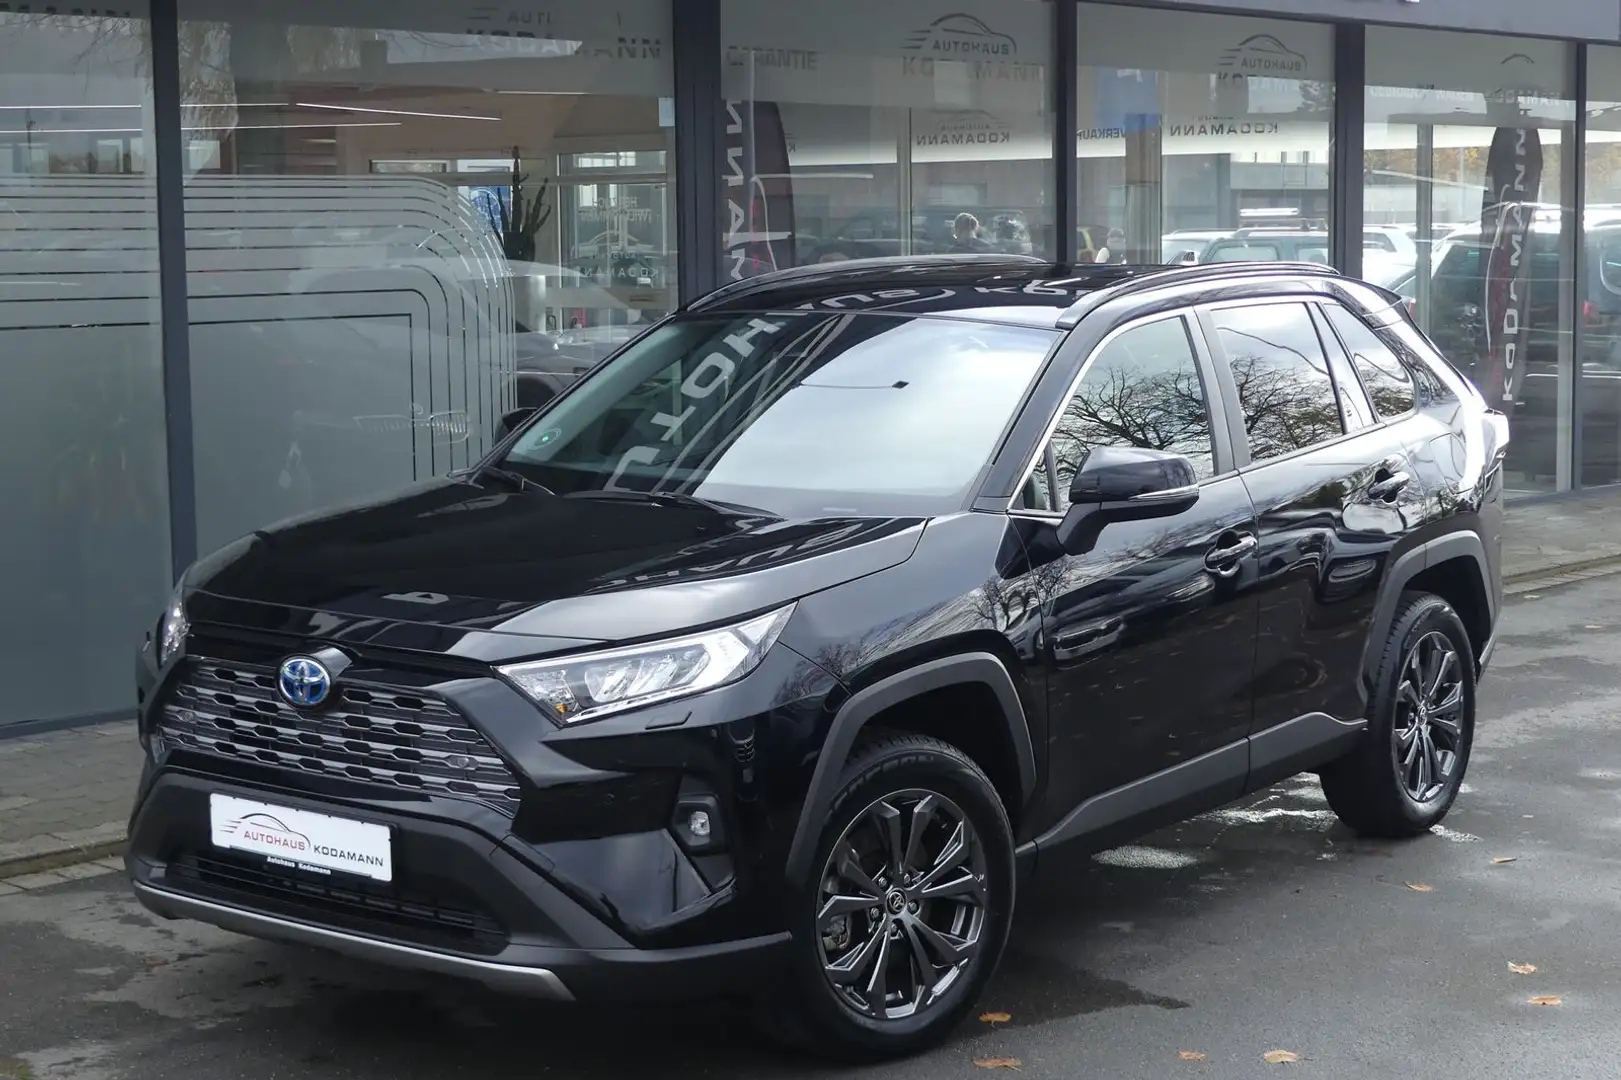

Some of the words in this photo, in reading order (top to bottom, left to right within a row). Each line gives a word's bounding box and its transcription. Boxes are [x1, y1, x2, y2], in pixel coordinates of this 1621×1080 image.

[932, 40, 1010, 55] AUTOHAUS
[1241, 58, 1301, 71] AUTOHAUS
[244, 830, 306, 851] AUTOHAUS
[313, 845, 384, 867] KODAMANN
